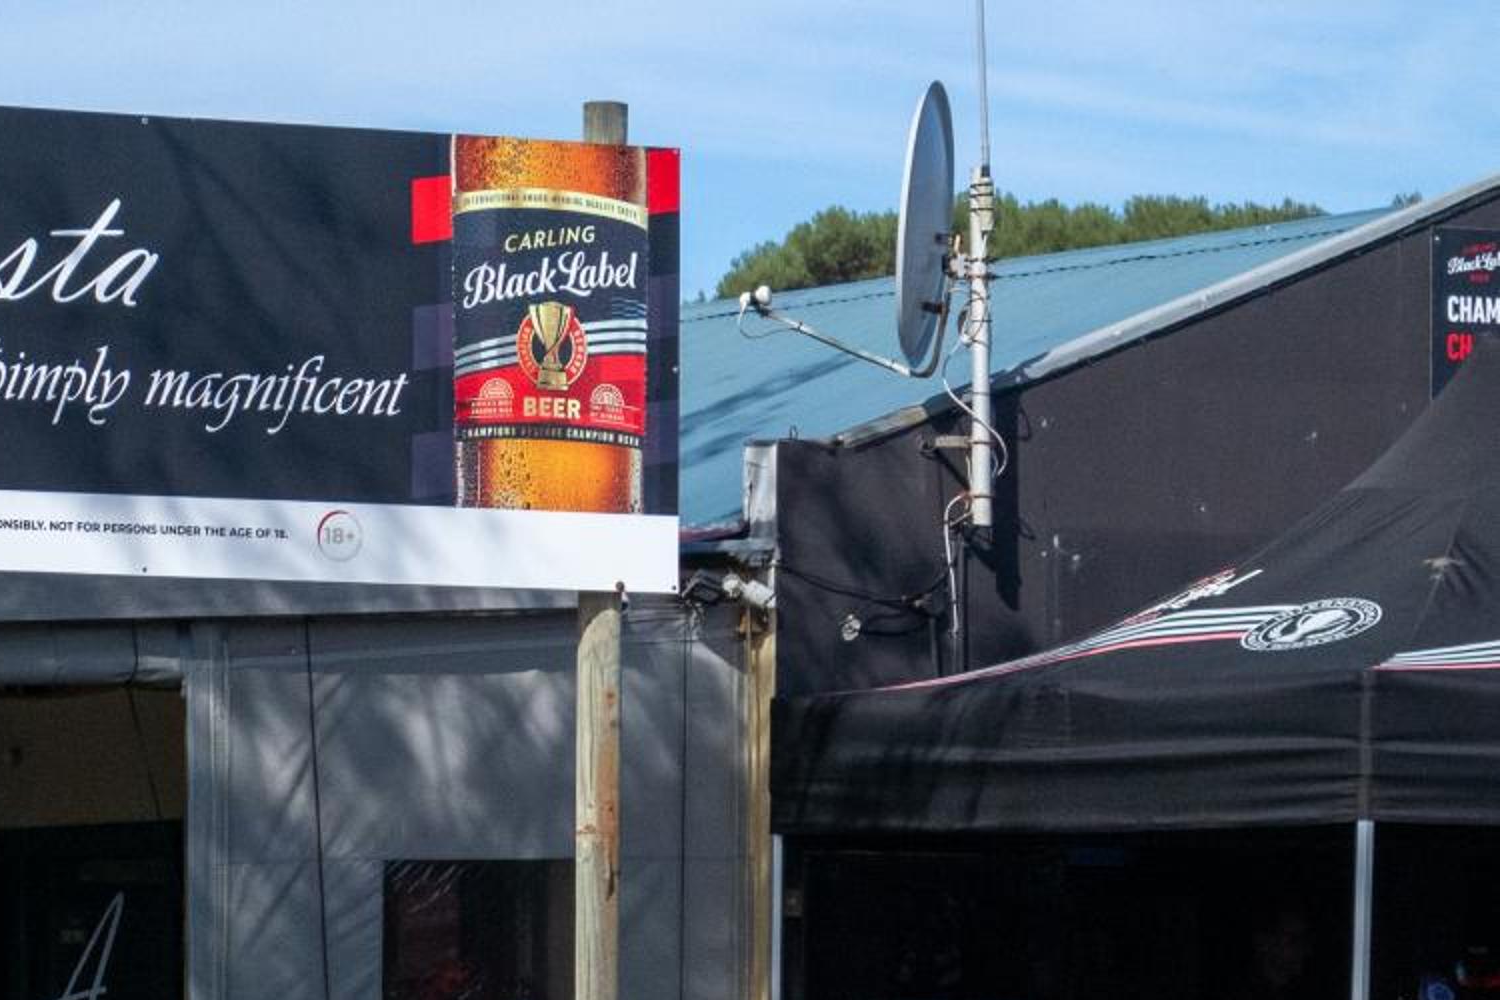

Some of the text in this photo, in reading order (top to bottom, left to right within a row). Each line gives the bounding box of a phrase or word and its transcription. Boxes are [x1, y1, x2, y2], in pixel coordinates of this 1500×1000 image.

[504, 225, 596, 253] CARLING
[463, 250, 639, 309] Black Label
[144, 356, 409, 434] magnificent
[523, 396, 582, 419] BEER
[50, 521, 73, 531] NOT
[77, 521, 101, 533] FOR
[103, 522, 157, 535] PERSONS
[160, 525, 201, 537] UNDER
[204, 527, 224, 537] THE
[229, 527, 252, 538] AGE
[255, 528, 271, 538] OF
[275, 528, 289, 539] 18.
[323, 526, 355, 545] 18+
